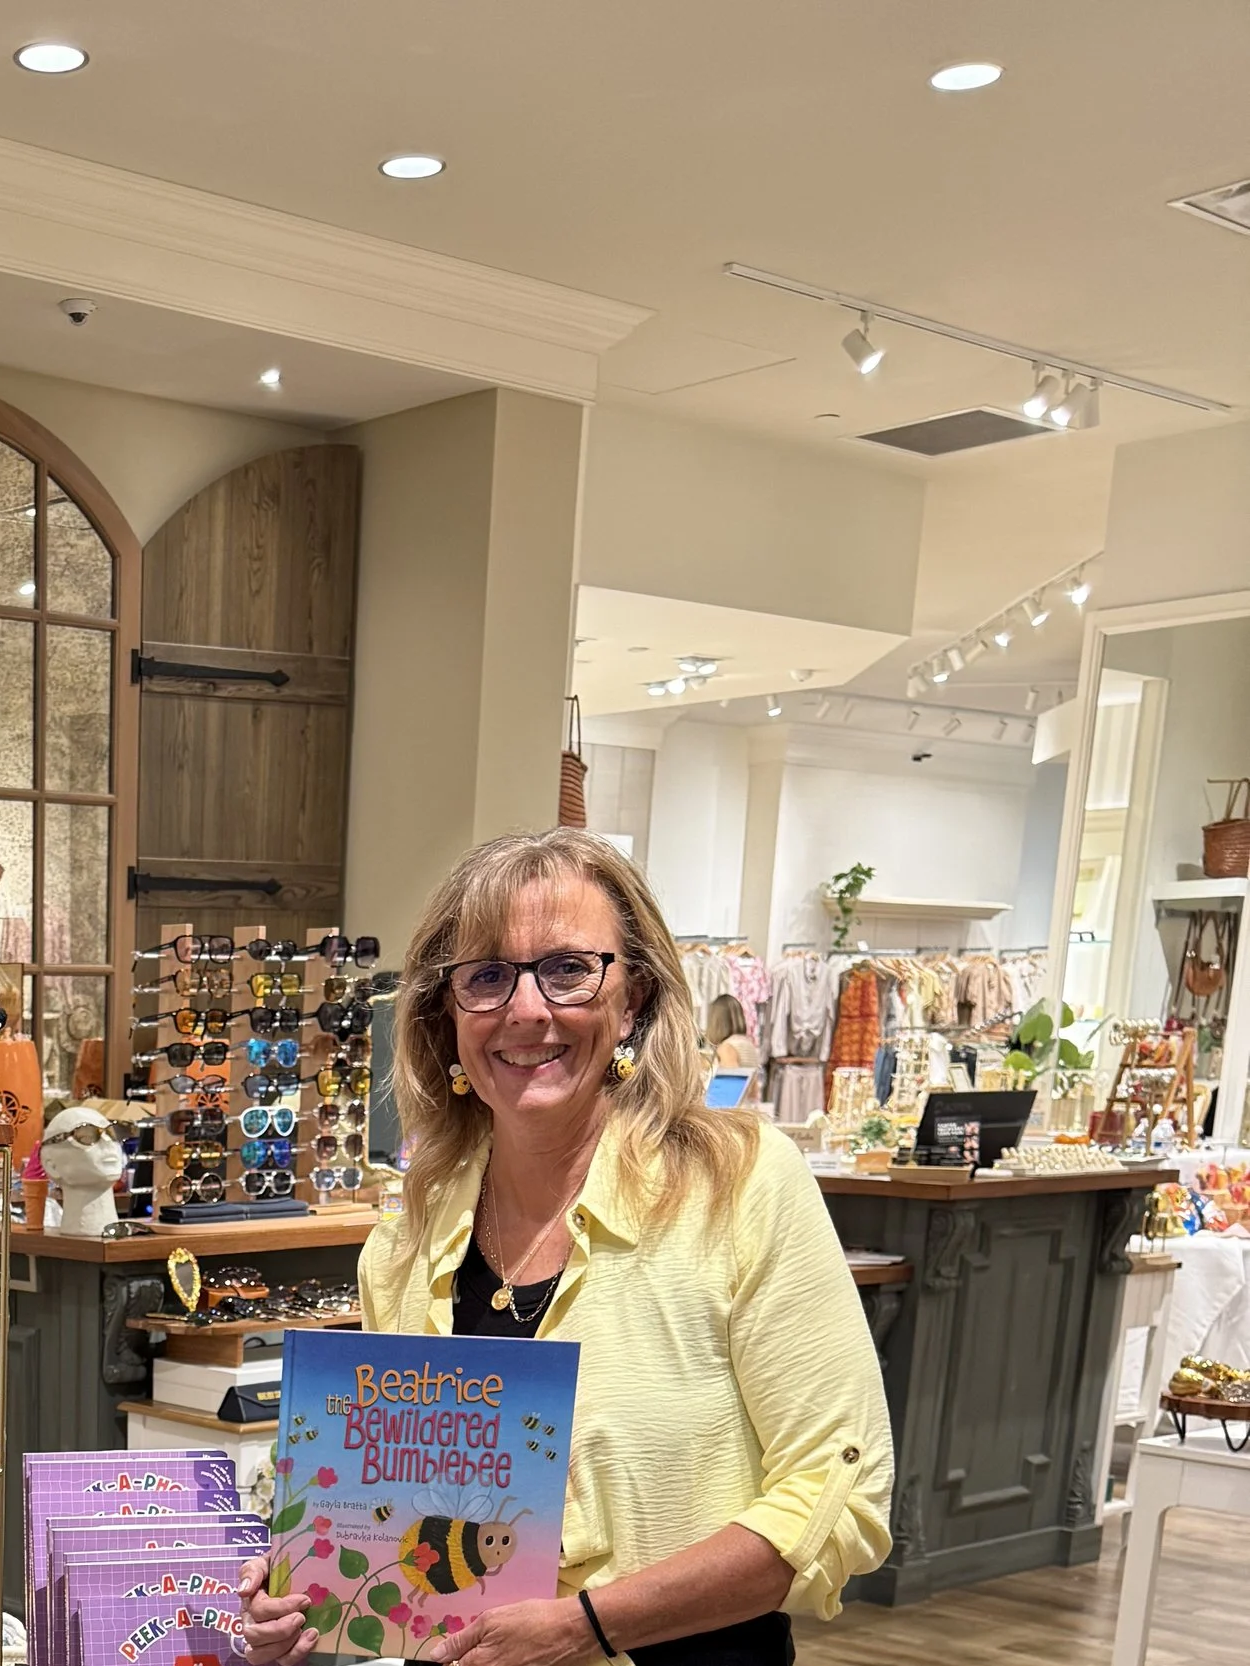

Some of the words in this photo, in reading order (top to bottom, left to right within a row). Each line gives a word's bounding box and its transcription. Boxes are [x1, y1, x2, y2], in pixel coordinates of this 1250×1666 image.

[325, 1393, 352, 1415] the
[355, 1362, 503, 1407] Beatrice
[344, 1403, 501, 1450] Bewildered
[361, 1443, 512, 1488] Bumblebee
[320, 1500, 341, 1511] Gayla
[343, 1501, 367, 1510] Bratta
[336, 1531, 371, 1543] Dubravka
[120, 1608, 243, 1661] PEEK-A-PHO
